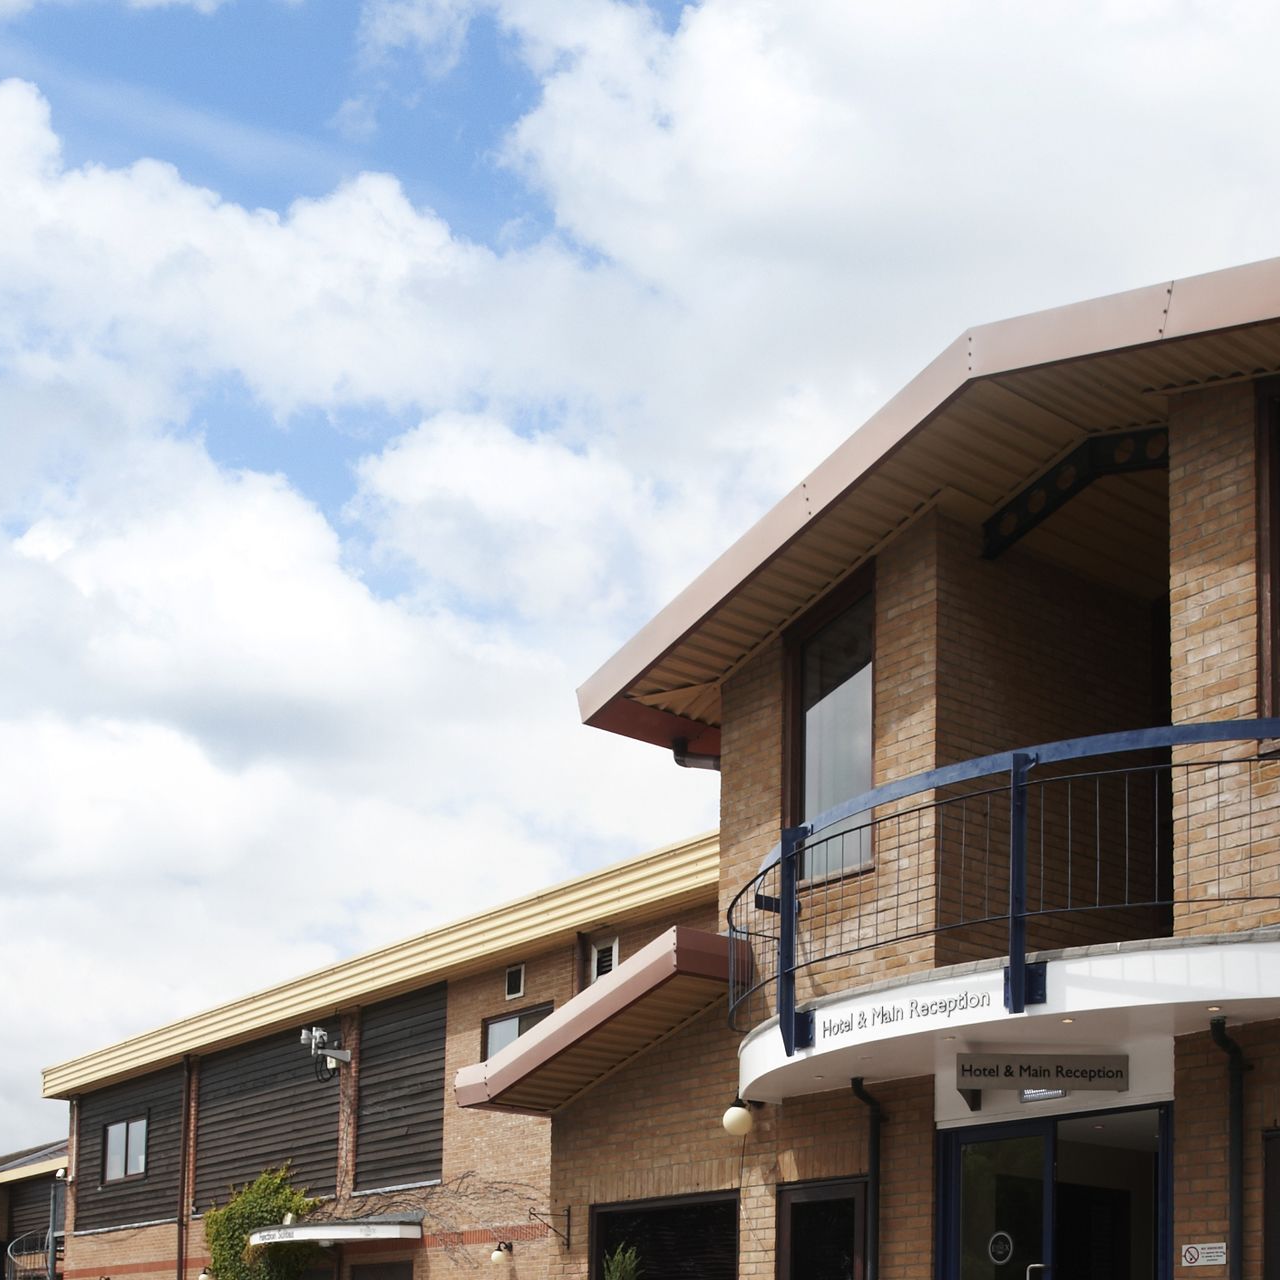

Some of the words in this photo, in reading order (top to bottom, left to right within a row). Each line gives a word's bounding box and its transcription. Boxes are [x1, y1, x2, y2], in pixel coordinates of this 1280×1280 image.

[822, 1013, 853, 1038] Hotel
[857, 1011, 867, 1029] &
[871, 1005, 904, 1026] Main
[909, 991, 991, 1018] Reception
[961, 1064, 999, 1078] Hotel
[1003, 1065, 1014, 1078] &
[1019, 1065, 1051, 1078] Main
[1055, 1065, 1124, 1081] Reception
